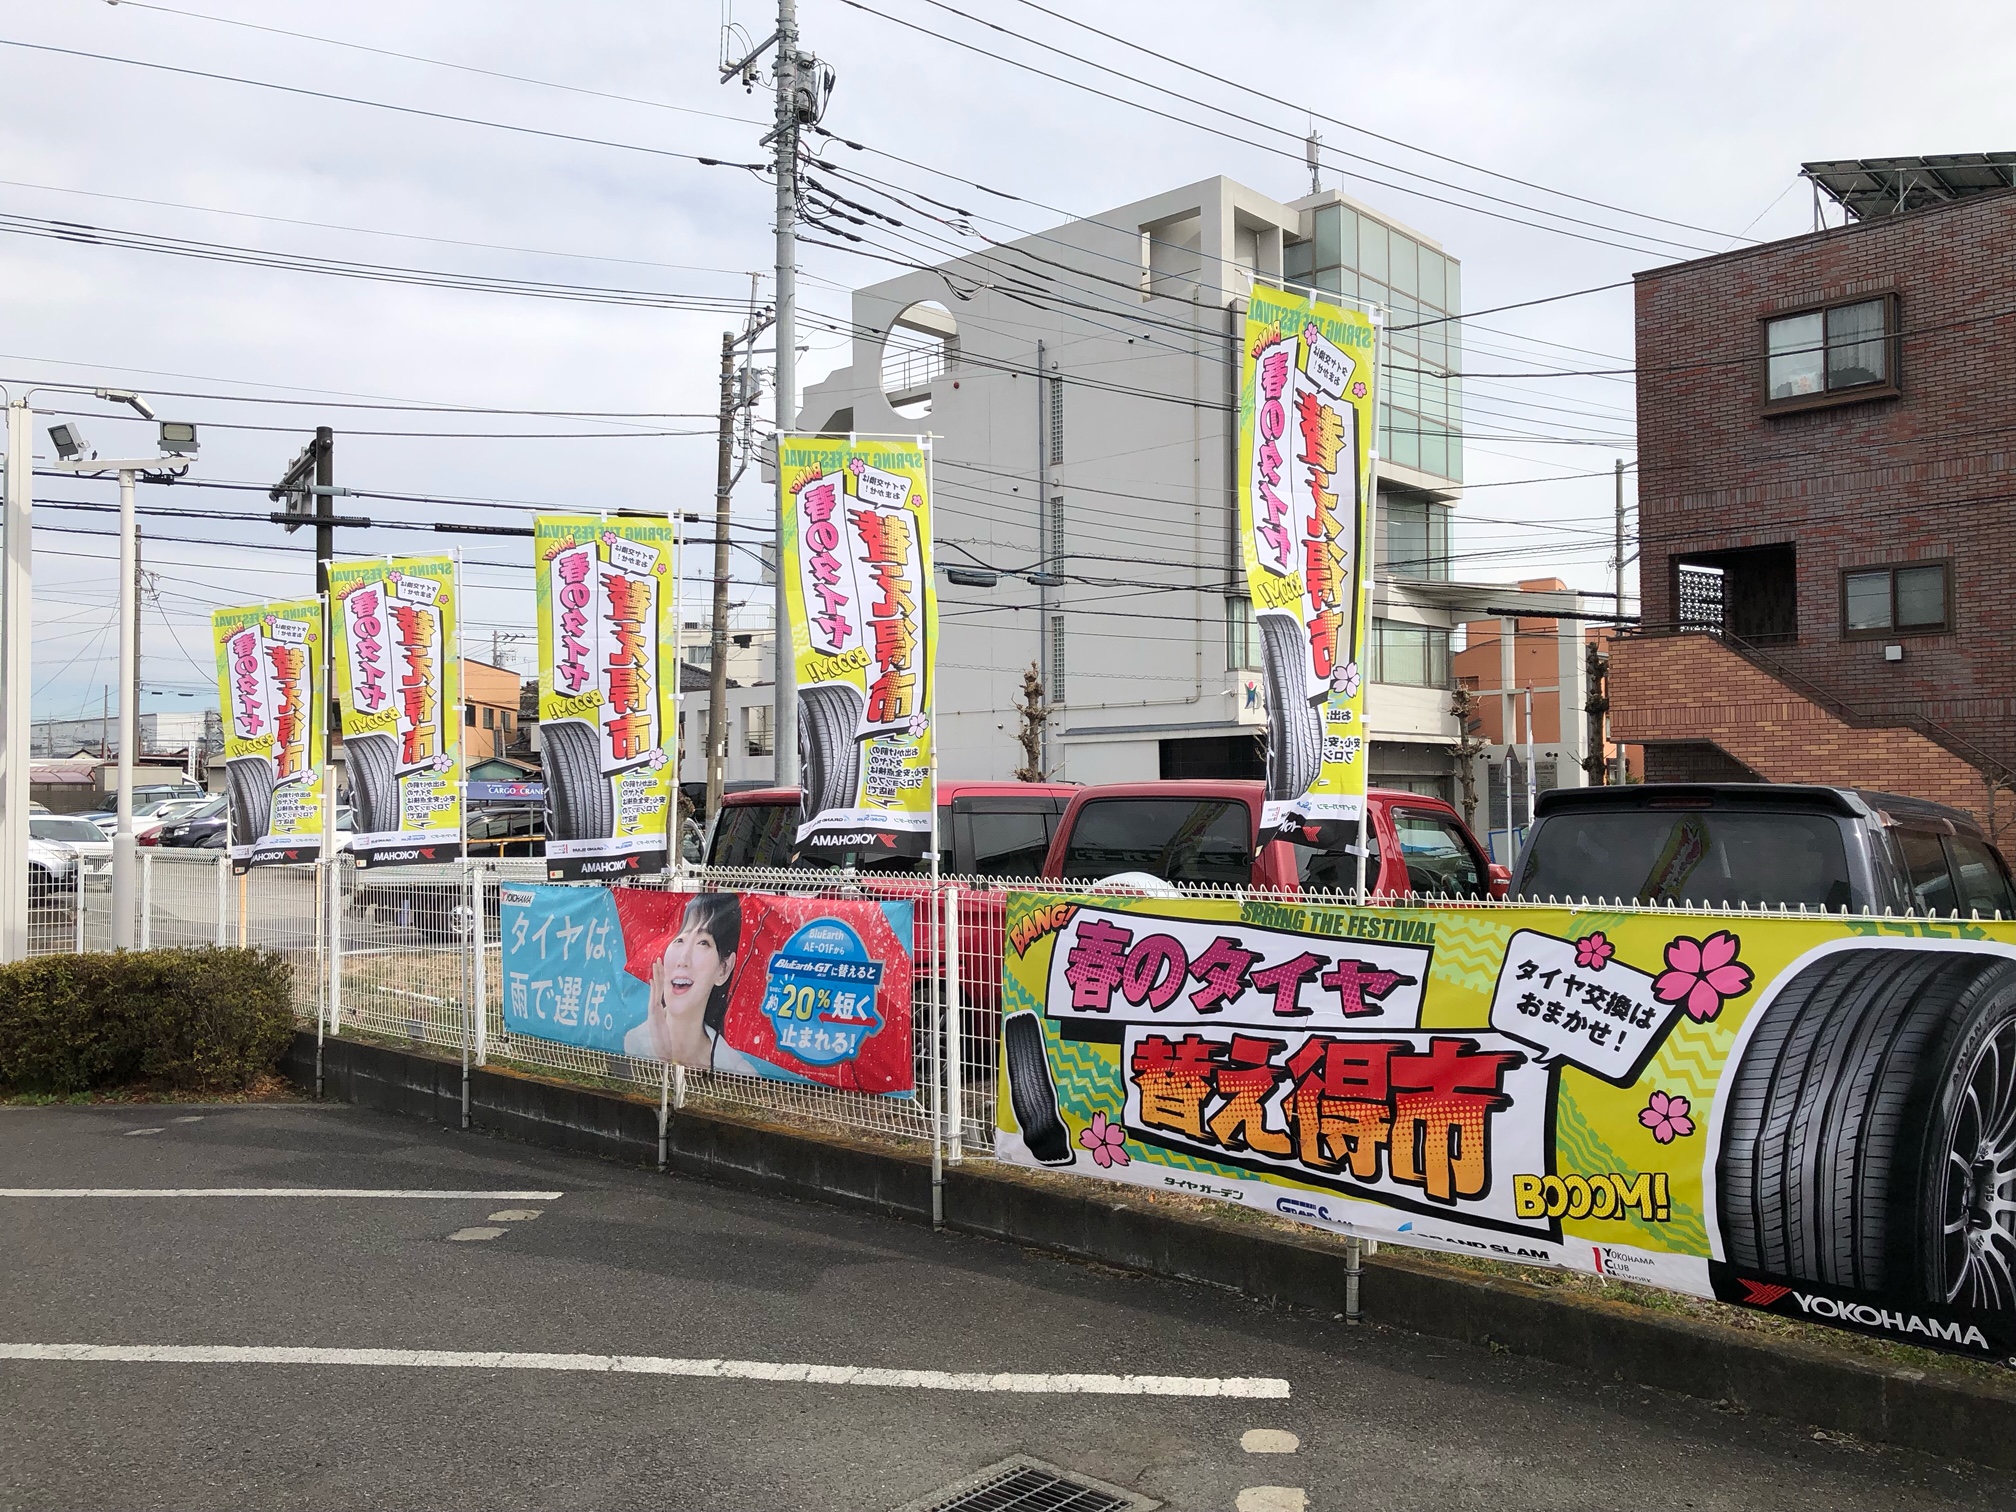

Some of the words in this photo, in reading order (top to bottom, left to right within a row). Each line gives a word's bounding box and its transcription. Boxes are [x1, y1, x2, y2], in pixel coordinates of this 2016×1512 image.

[488, 787, 516, 795] CARGO
[808, 928, 845, 940] BluEarth
[1010, 902, 1079, 960] BANG!
[1240, 901, 1306, 931] SPRING
[1309, 910, 1344, 937] THE
[1345, 914, 1437, 945] FESTIVAL
[1065, 917, 1417, 1018] 春のタイヤ
[509, 971, 613, 1031] 雨で選ぼ。
[1514, 958, 1657, 1031] タイヤ交換は
[1130, 1033, 1526, 1206] 替え得市
[1163, 1176, 1244, 1200] タイヤガーデン
[1513, 1170, 1671, 1223] BOOOM!
[1603, 1247, 1656, 1267] YOKOHAMA
[1604, 1259, 1630, 1272] CLUB
[1792, 1292, 1990, 1351] YOKOHAMA
